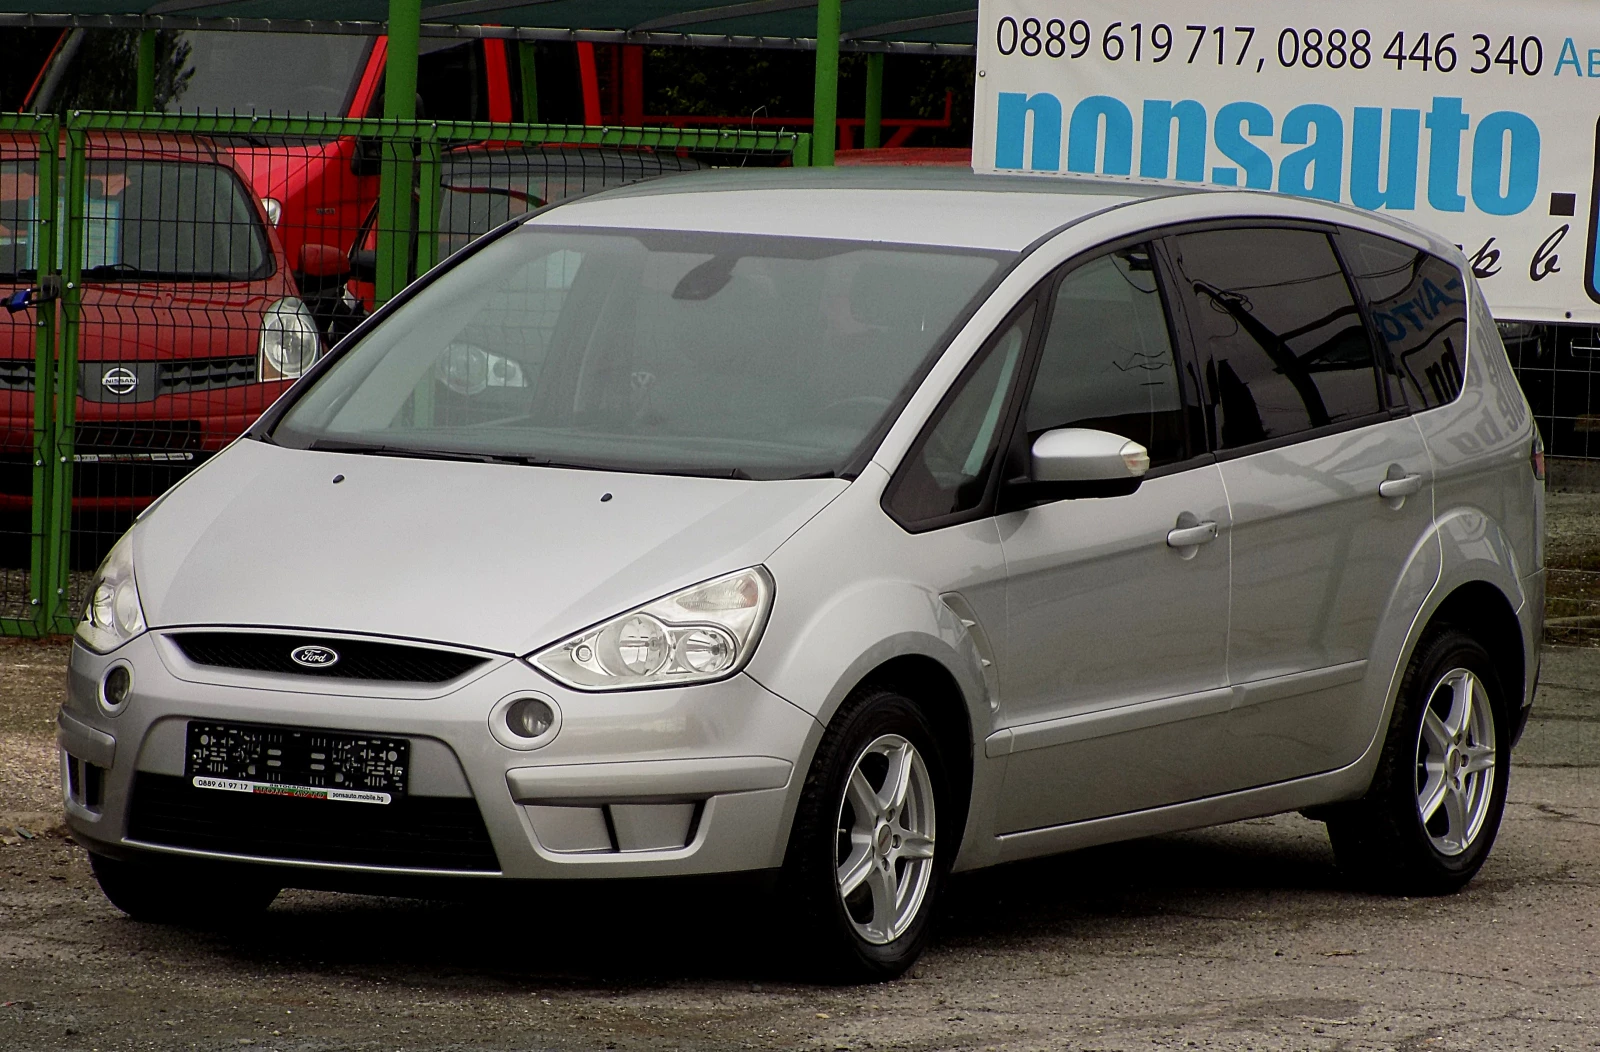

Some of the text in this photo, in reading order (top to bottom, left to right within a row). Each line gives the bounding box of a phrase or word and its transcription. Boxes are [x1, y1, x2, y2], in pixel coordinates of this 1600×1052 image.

[997, 17, 1543, 76] 0889 619 717, 0888 446 340
[301, 649, 327, 662] Ford
[198, 779, 249, 791] 0889 61 97 17
